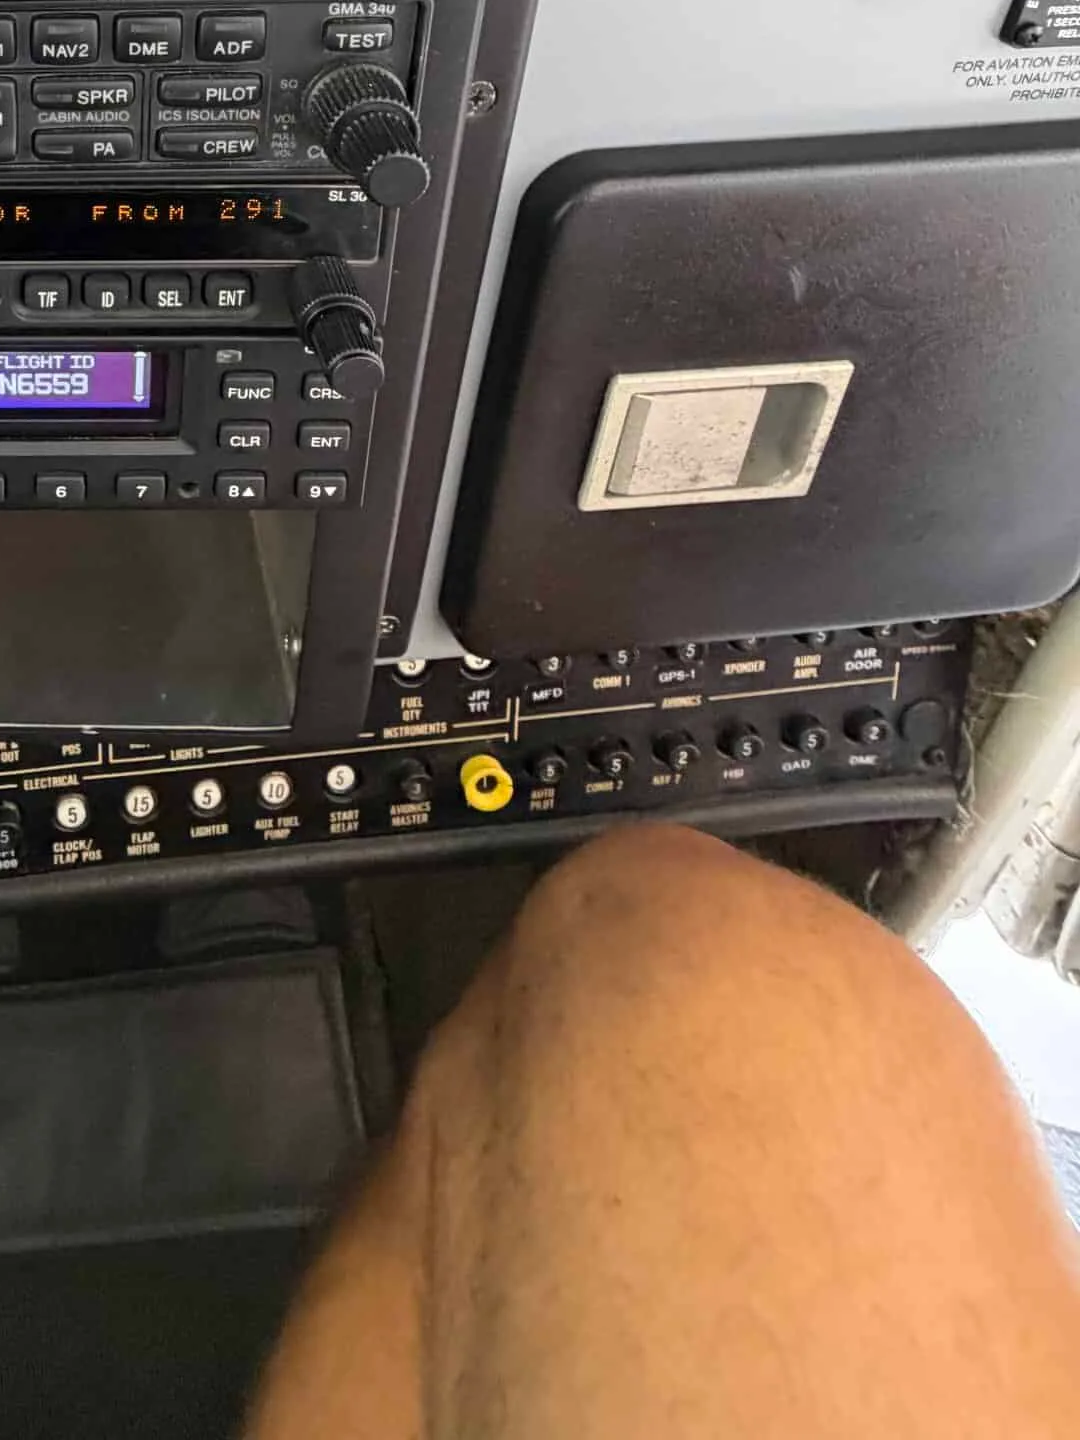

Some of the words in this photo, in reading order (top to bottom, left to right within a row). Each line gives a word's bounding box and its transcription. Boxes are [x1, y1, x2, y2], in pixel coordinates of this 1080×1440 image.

[328, 3, 364, 16] GMA
[214, 41, 253, 55] ADF
[336, 33, 386, 49] TEST
[42, 43, 88, 58] NAV2
[128, 42, 168, 56] DME
[953, 60, 984, 72] FOR
[986, 56, 1054, 71] AVIATION
[77, 89, 127, 104] SPKR
[206, 86, 257, 101] PILOT
[38, 111, 80, 122] CABIN
[85, 111, 130, 122] AUDIO
[158, 110, 181, 120] ICS
[186, 109, 260, 120] ISOLATION
[93, 143, 115, 157] PA
[203, 139, 255, 155] CREW
[329, 190, 346, 202] SL
[92, 205, 185, 221] FROM
[220, 200, 285, 221] 291
[38, 292, 57, 308] T/F
[102, 292, 114, 307] ID
[158, 292, 183, 307] SEL
[219, 290, 245, 307] ENT
[70, 354, 95, 369] ID
[228, 388, 272, 399] FUNC
[230, 436, 261, 448] CLR
[311, 436, 342, 448] ENT
[854, 647, 877, 659] AIR
[845, 659, 882, 672] DOOR
[468, 689, 490, 702] JPI
[532, 687, 563, 701] MFD
[401, 697, 423, 709] FUEL
[383, 722, 447, 739] INSTRUMENTS
[170, 747, 204, 761] LIGHTS
[23, 773, 80, 790] ELECTRICAL
[268, 783, 284, 799] 10
[133, 796, 150, 811] 15
[391, 801, 431, 816] AVIONICS
[277, 816, 301, 828] FUEL
[330, 810, 359, 823] START
[392, 813, 429, 827] MASTER
[190, 824, 229, 838] LIGHTER
[330, 822, 359, 834] RELAY
[132, 832, 155, 843] FLAP
[127, 843, 160, 856] MOTOR
[53, 853, 78, 865] FLAP
[83, 849, 102, 861] POS
